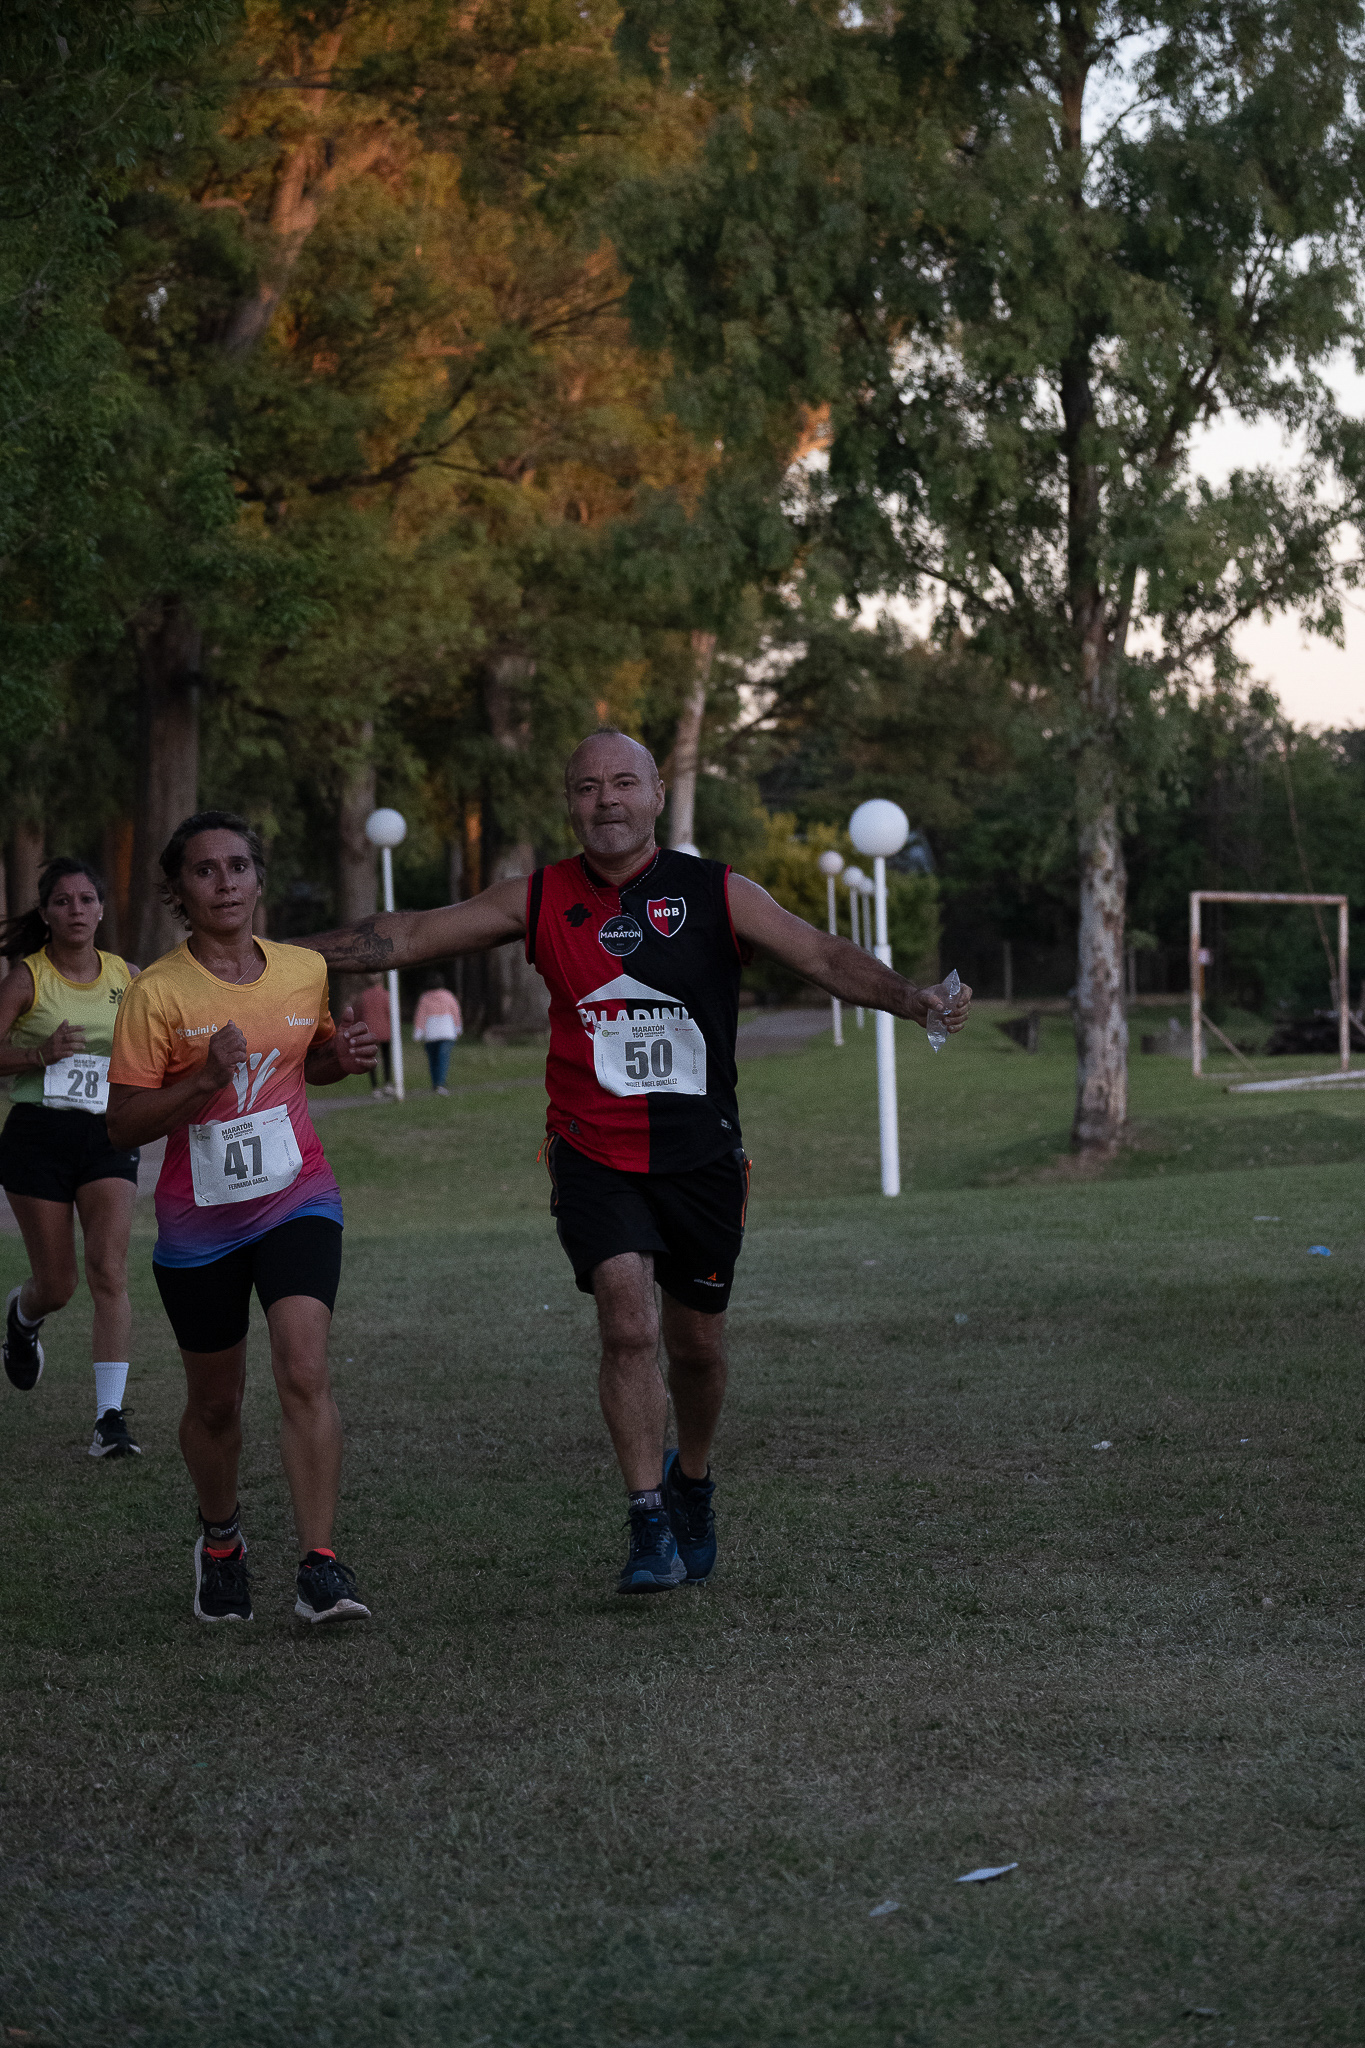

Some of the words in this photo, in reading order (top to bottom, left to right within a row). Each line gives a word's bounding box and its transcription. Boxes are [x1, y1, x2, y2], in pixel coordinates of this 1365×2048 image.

[653, 907, 680, 918] NOB
[600, 929, 641, 939] MARATÓN
[210, 1023, 218, 1033] 6
[631, 1024, 665, 1033] MARATÓN
[625, 1039, 673, 1080] 50
[67, 1069, 100, 1099] 28
[221, 1122, 254, 1137] MARATÓN
[222, 1133, 234, 1141] 150
[223, 1135, 263, 1181] 47
